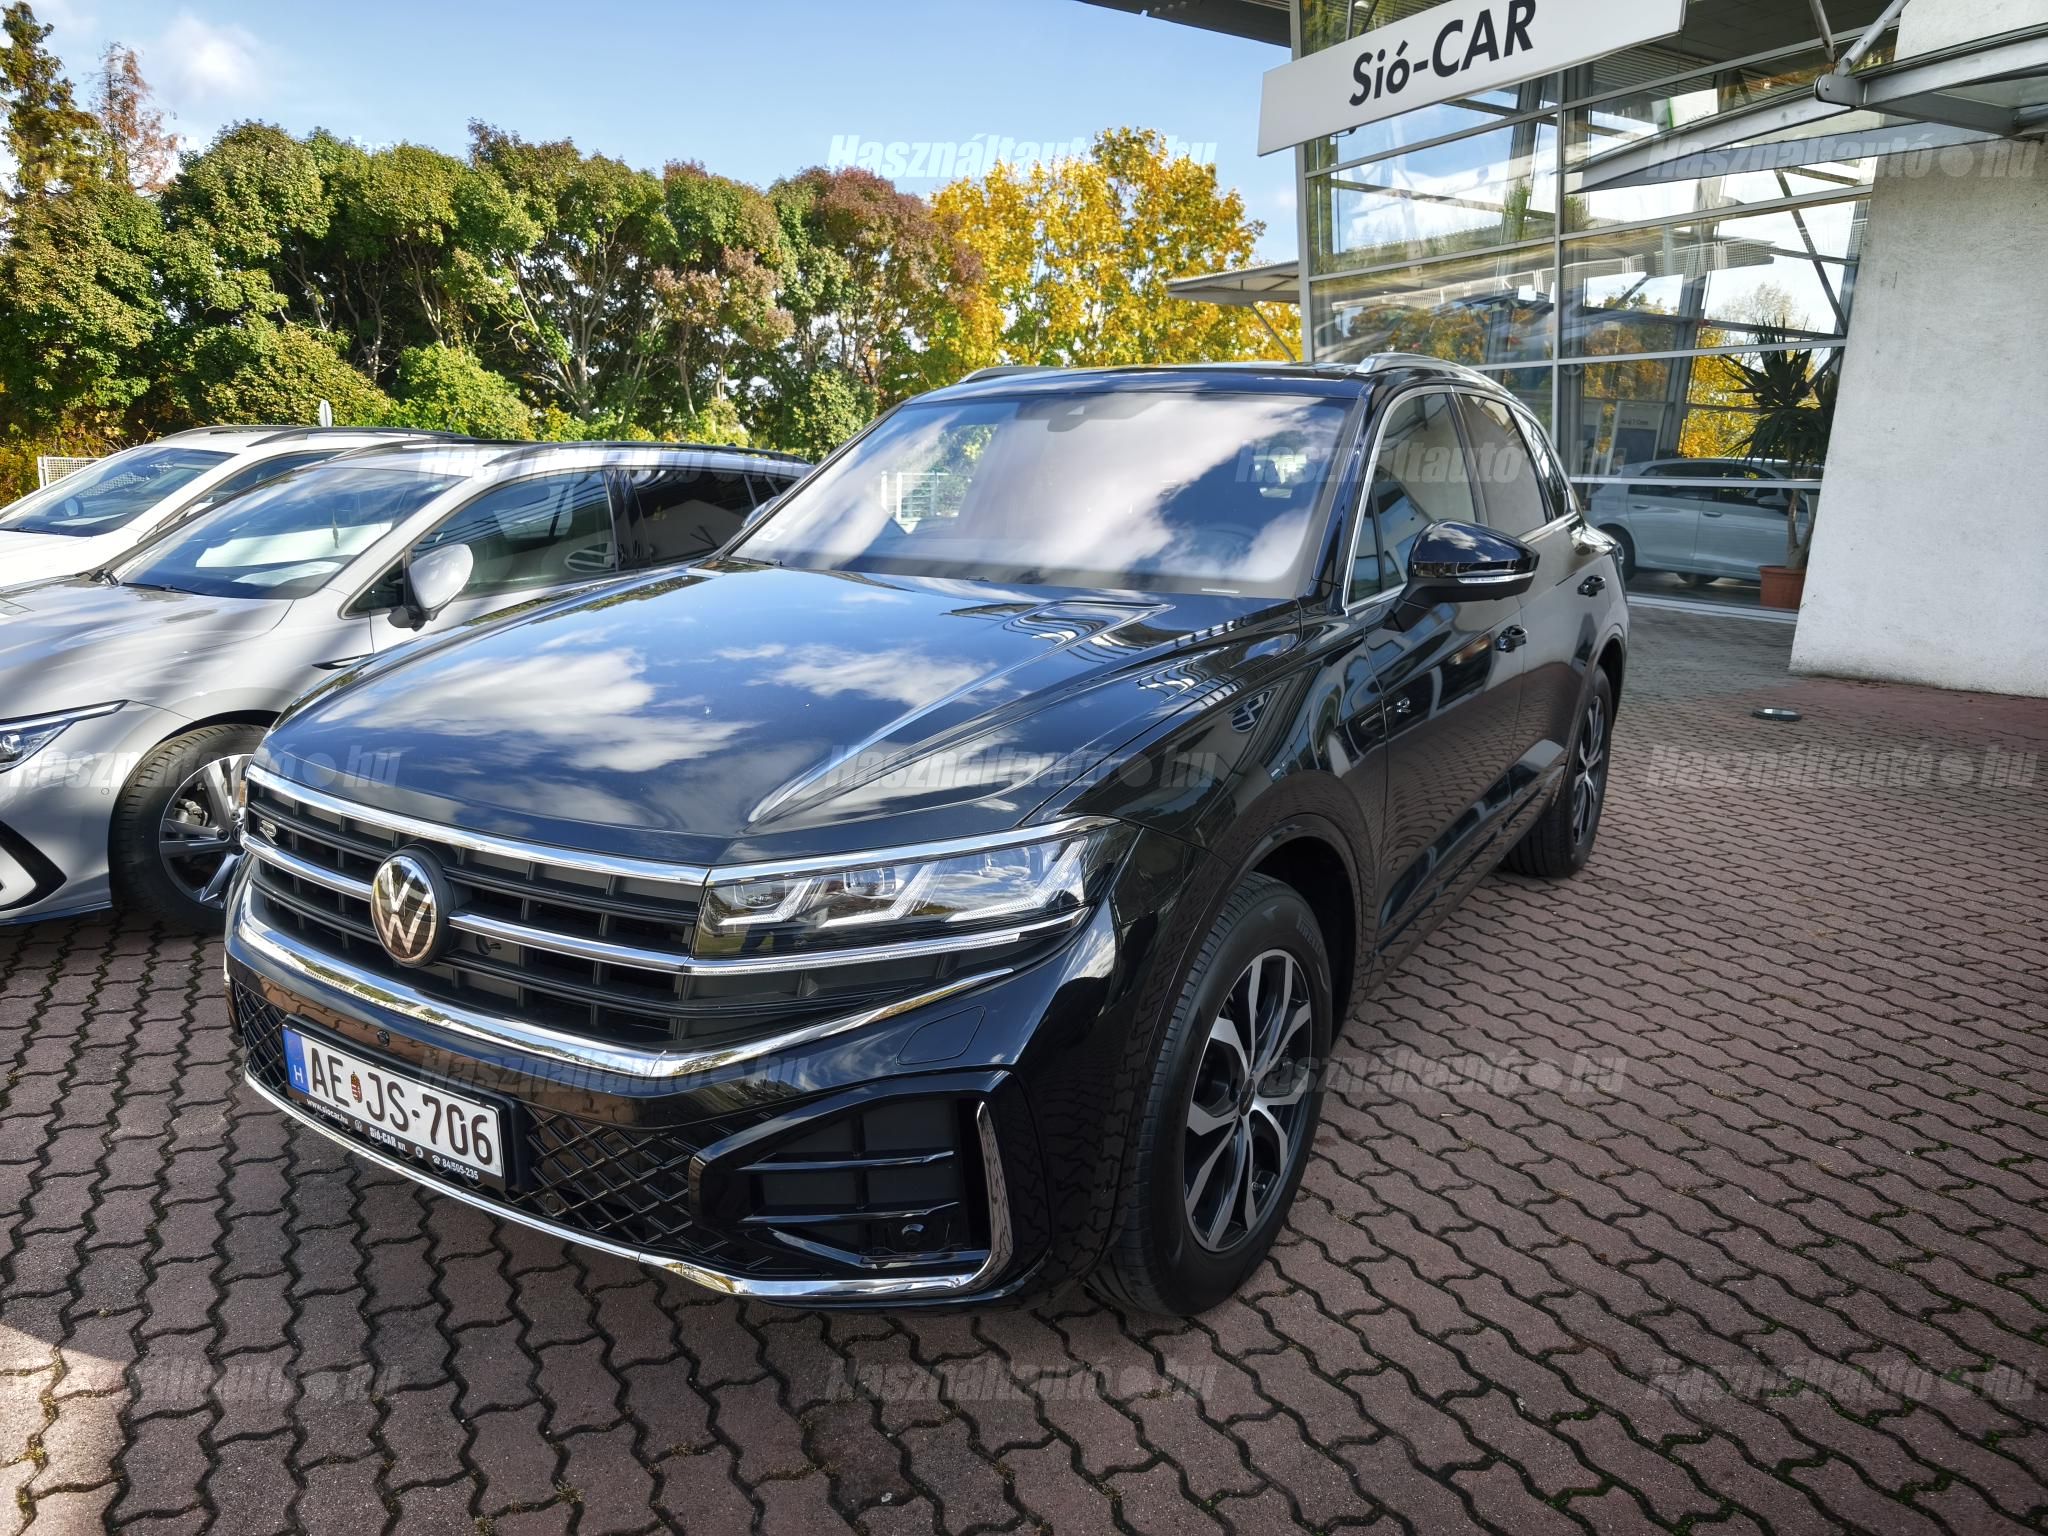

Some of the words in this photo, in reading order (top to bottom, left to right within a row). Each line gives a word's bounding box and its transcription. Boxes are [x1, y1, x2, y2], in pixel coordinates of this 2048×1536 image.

[1349, 0, 1537, 107] Sió-CAR
[293, 1064, 304, 1084] H
[311, 1047, 350, 1108] AE
